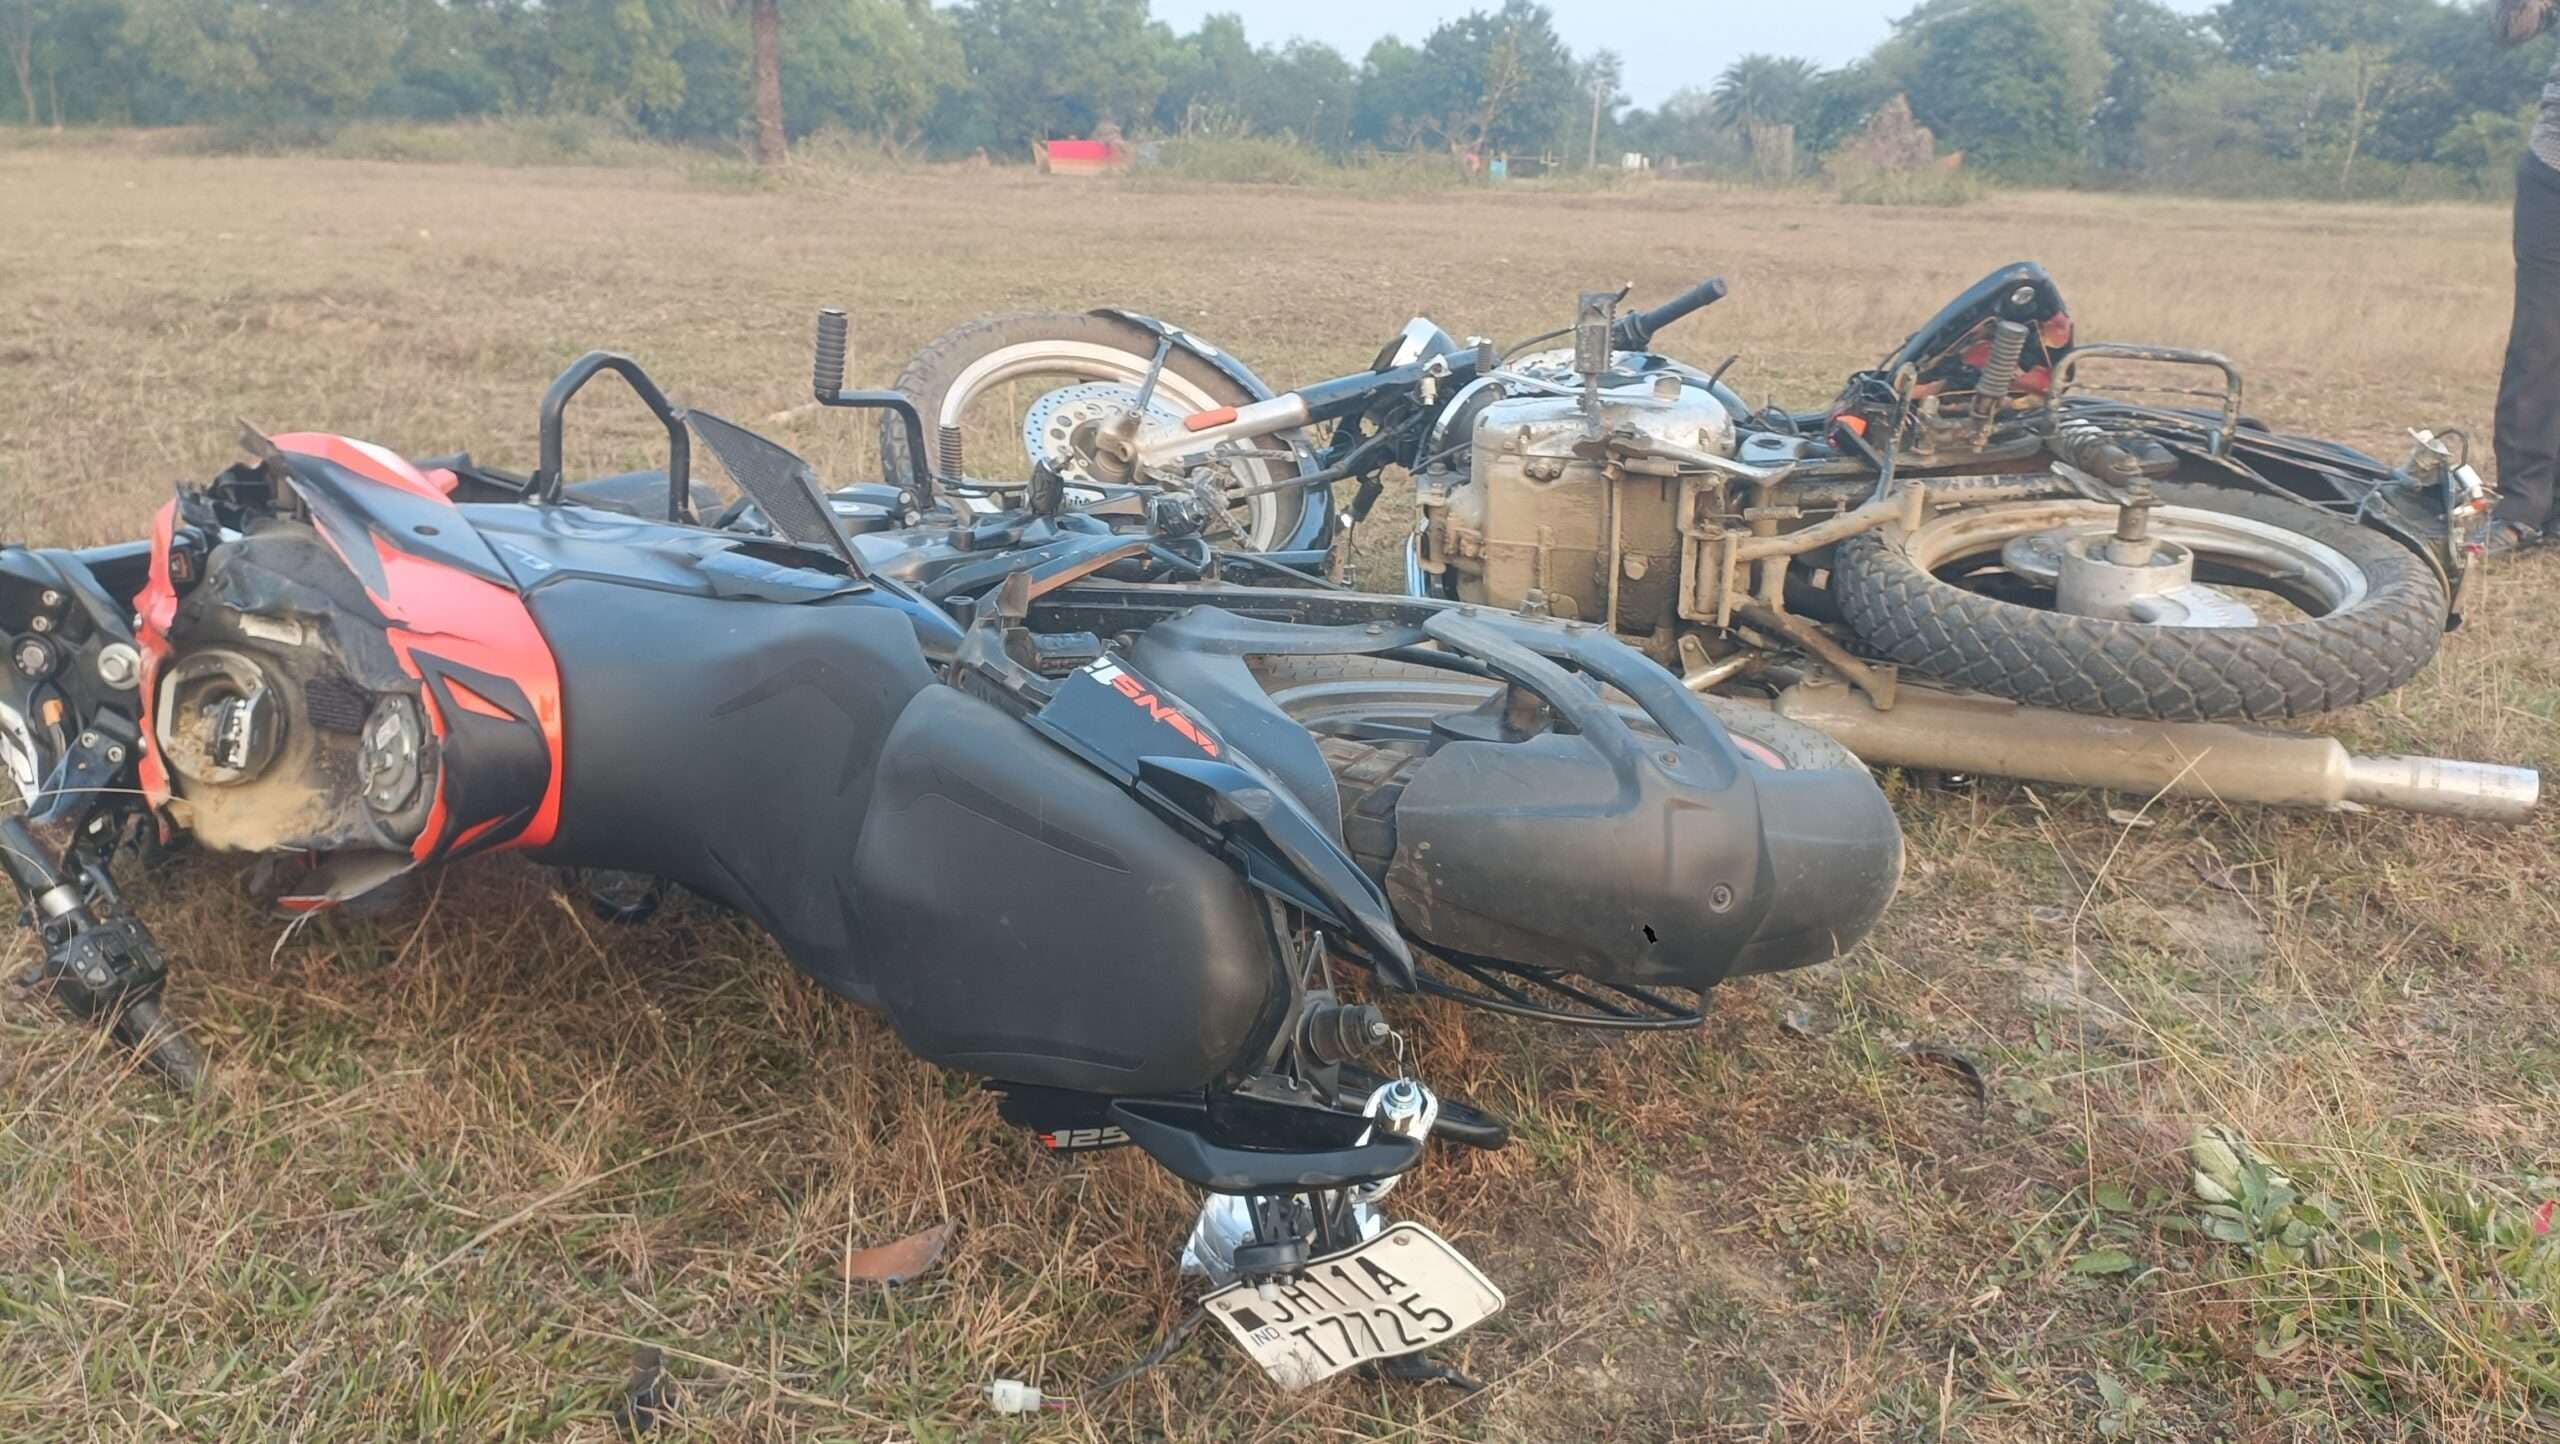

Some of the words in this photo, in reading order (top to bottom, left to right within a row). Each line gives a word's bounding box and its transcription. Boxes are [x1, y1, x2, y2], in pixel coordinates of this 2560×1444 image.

[1051, 1126, 1131, 1148] 125
[1251, 1326, 1281, 1346] IND
[1290, 1294, 1454, 1366] T7725
